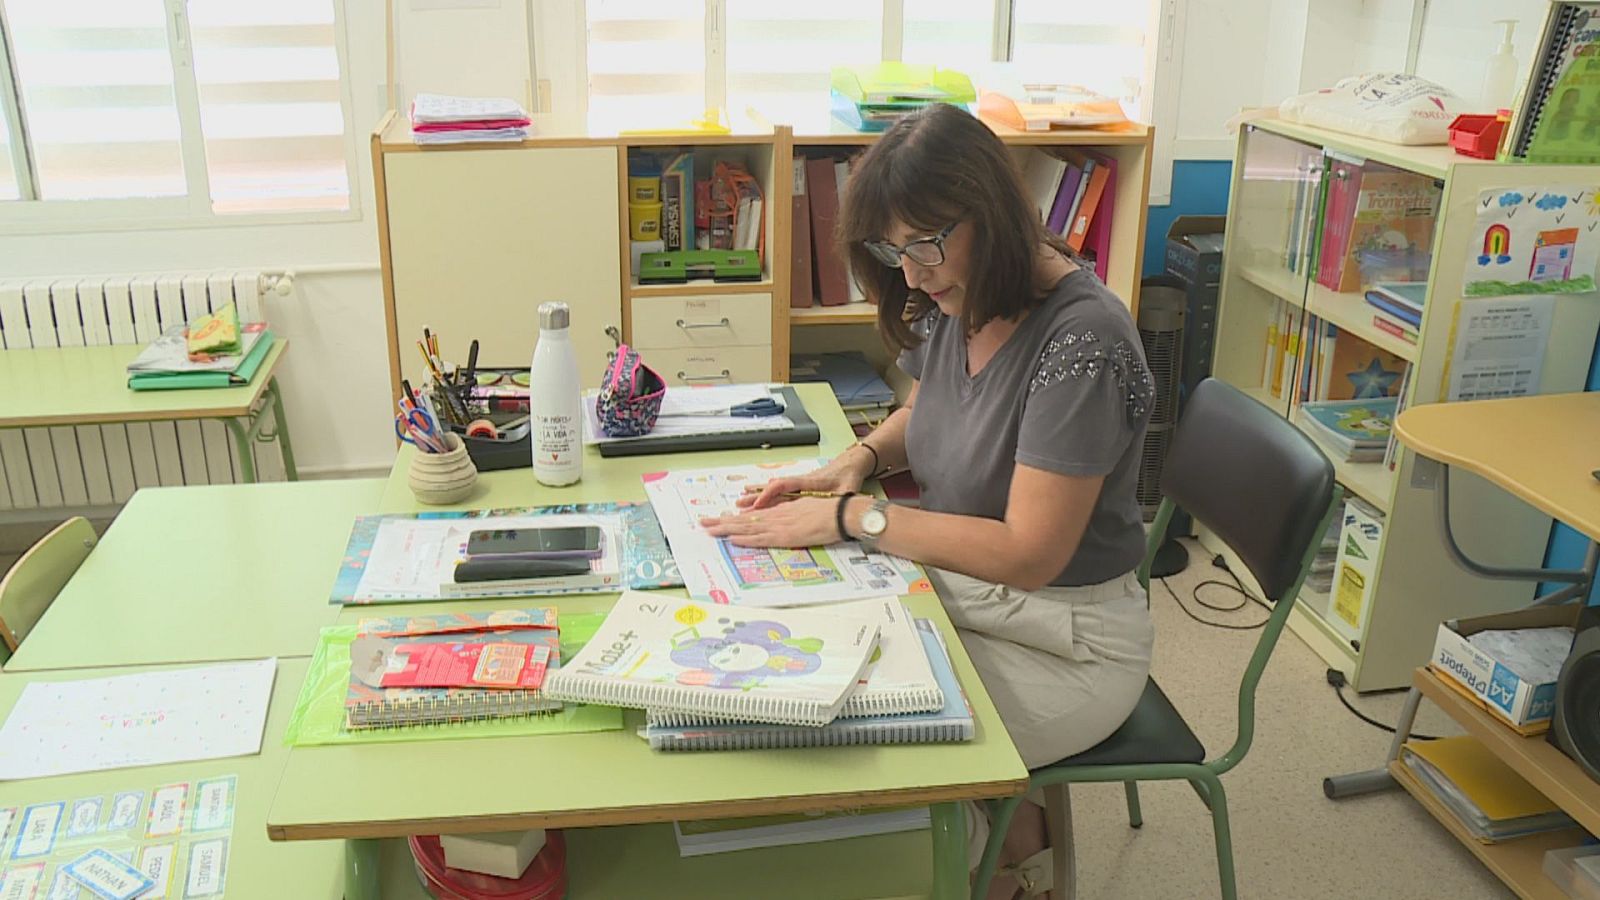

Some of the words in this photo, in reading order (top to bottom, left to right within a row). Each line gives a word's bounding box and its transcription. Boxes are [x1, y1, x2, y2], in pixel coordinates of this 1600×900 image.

[1439, 651, 1477, 688] Report
[1488, 680, 1514, 705] A4
[149, 856, 163, 880] PEDR
[197, 848, 214, 887] SAMUEL
